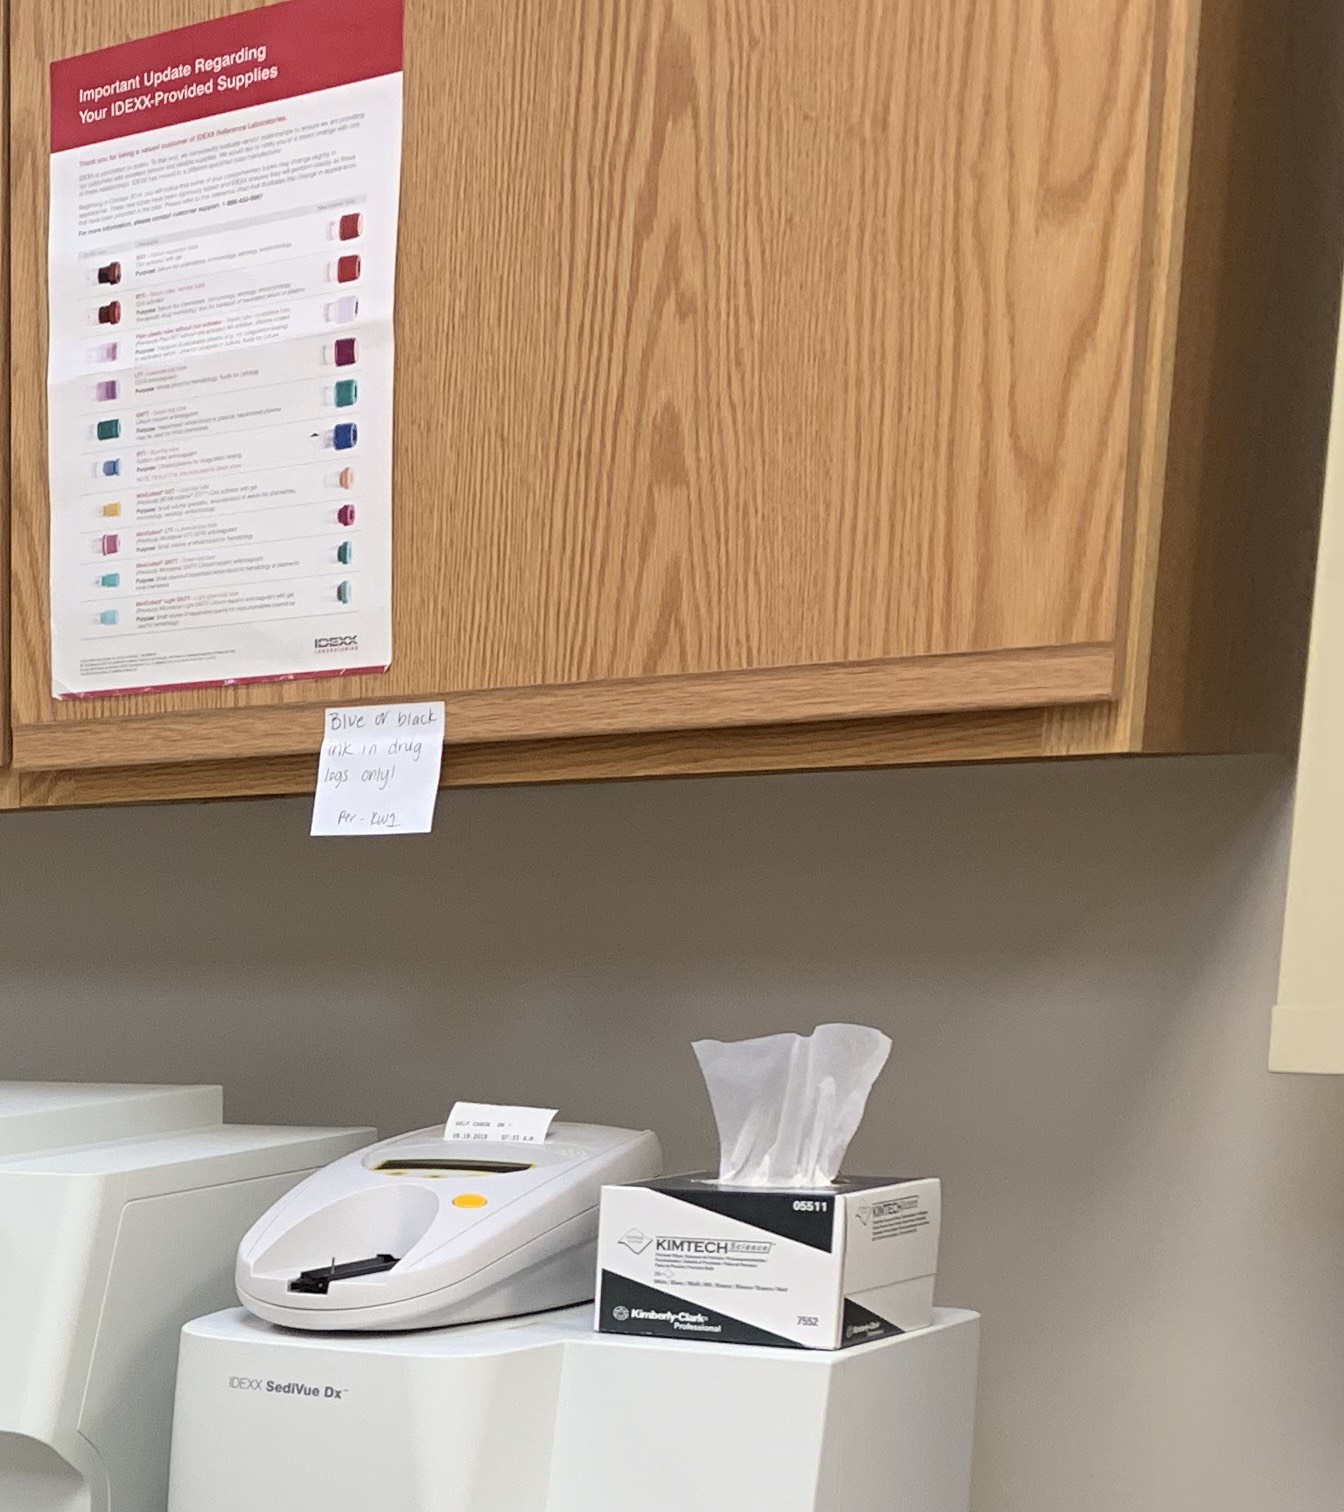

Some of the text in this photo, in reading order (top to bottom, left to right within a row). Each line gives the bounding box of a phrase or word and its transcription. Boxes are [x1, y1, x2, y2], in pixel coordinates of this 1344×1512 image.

[79, 43, 268, 103] Important Update Regarding
[79, 64, 278, 126] Your IDEXX-Provided Supplies
[314, 635, 358, 649] IDEXX
[329, 708, 438, 731] Blue or black
[328, 742, 423, 761] ink in drug
[324, 765, 396, 790] logs only!
[792, 1201, 828, 1213] 05511
[655, 1239, 728, 1255] KIMTECH
[730, 1242, 769, 1253] Science
[673, 1320, 722, 1333] Professional
[797, 1316, 819, 1327] 7552
[229, 1376, 263, 1391] IDEXX
[266, 1380, 321, 1397] SediVue
